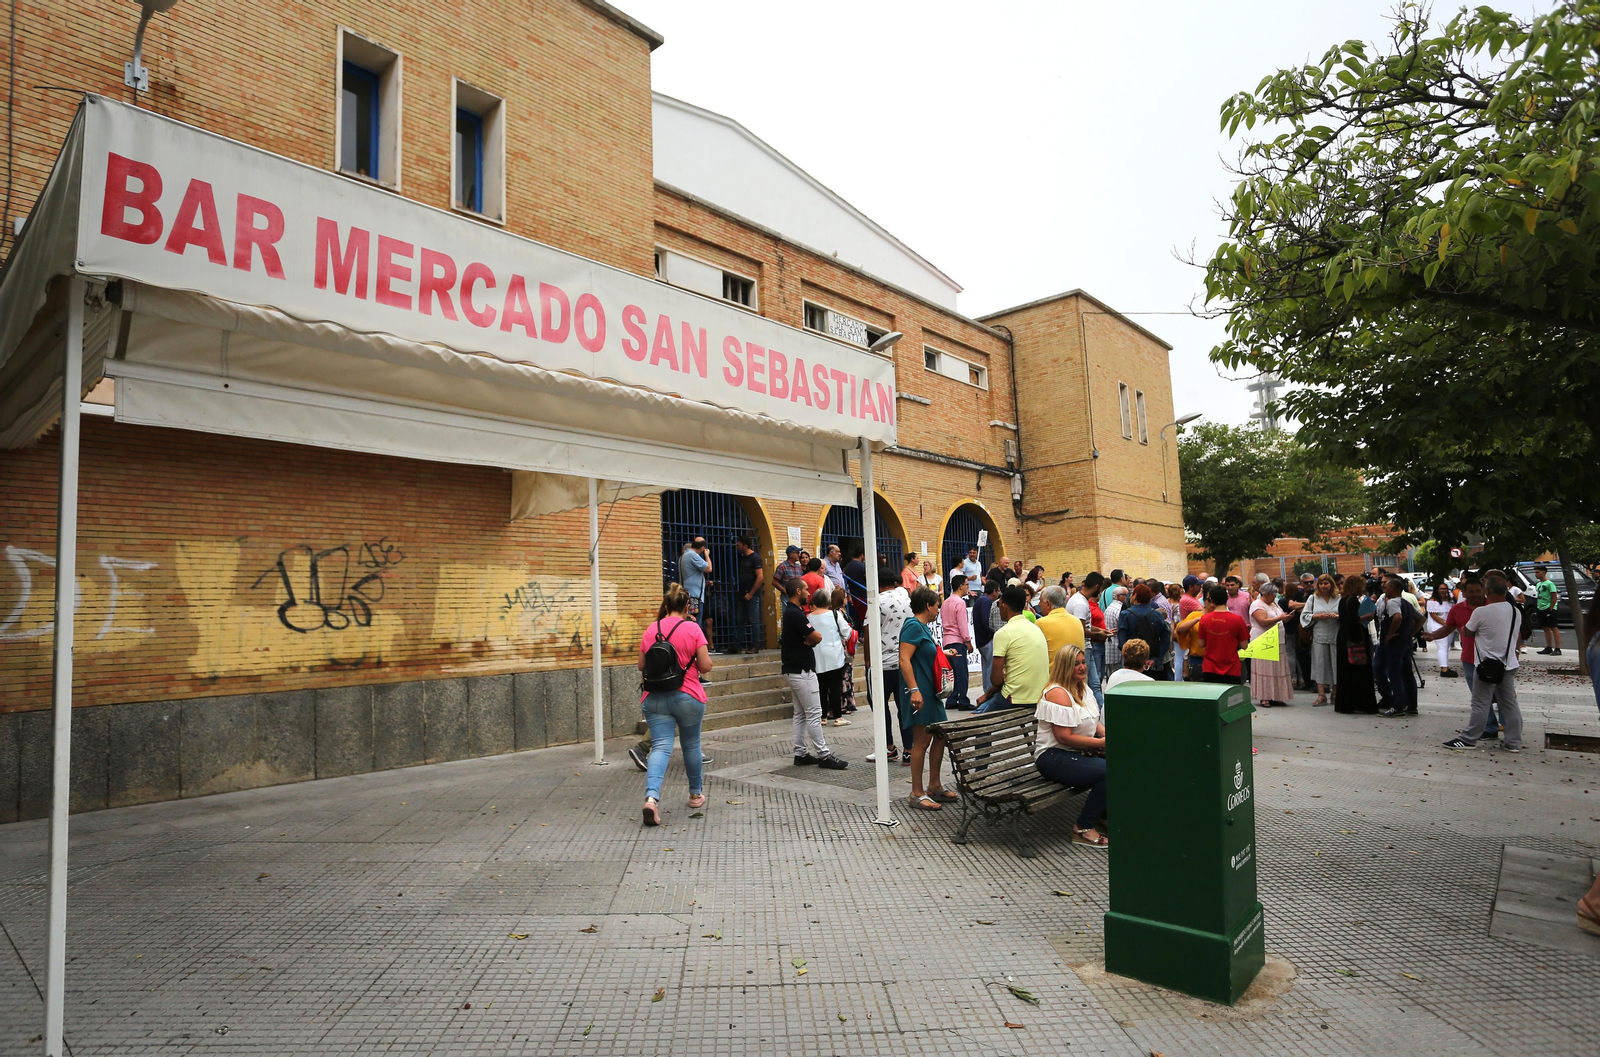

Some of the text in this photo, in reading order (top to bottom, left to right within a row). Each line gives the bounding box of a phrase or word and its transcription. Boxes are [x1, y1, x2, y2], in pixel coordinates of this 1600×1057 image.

[101, 152, 895, 427] BAR MERCADO SAN SEBASTIAN
[833, 314, 864, 331] MERCADO
[836, 321, 862, 337] DE SAN
[830, 325, 868, 345] SEBASTIAN
